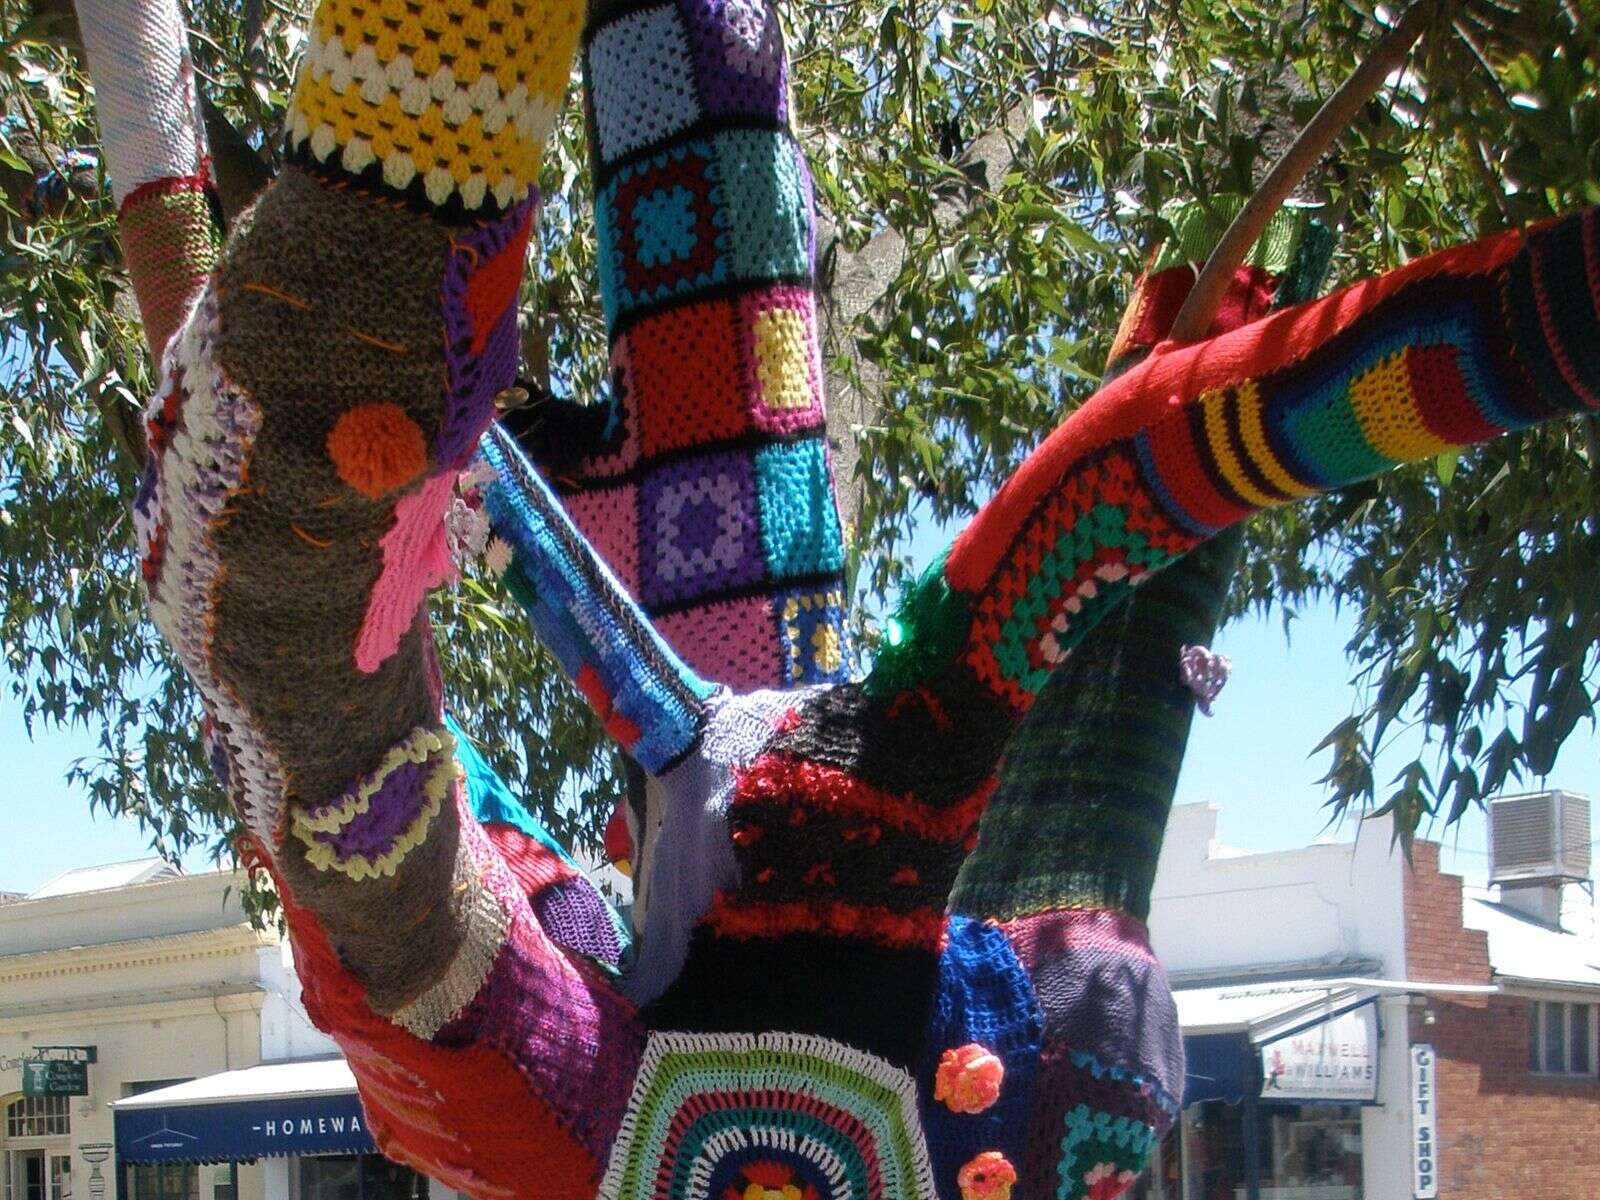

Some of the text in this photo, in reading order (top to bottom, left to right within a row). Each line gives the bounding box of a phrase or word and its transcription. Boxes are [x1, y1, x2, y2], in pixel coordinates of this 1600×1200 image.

[1295, 1063, 1373, 1080] WILLIAMS
[1416, 1051, 1432, 1190] GIFT SHOP
